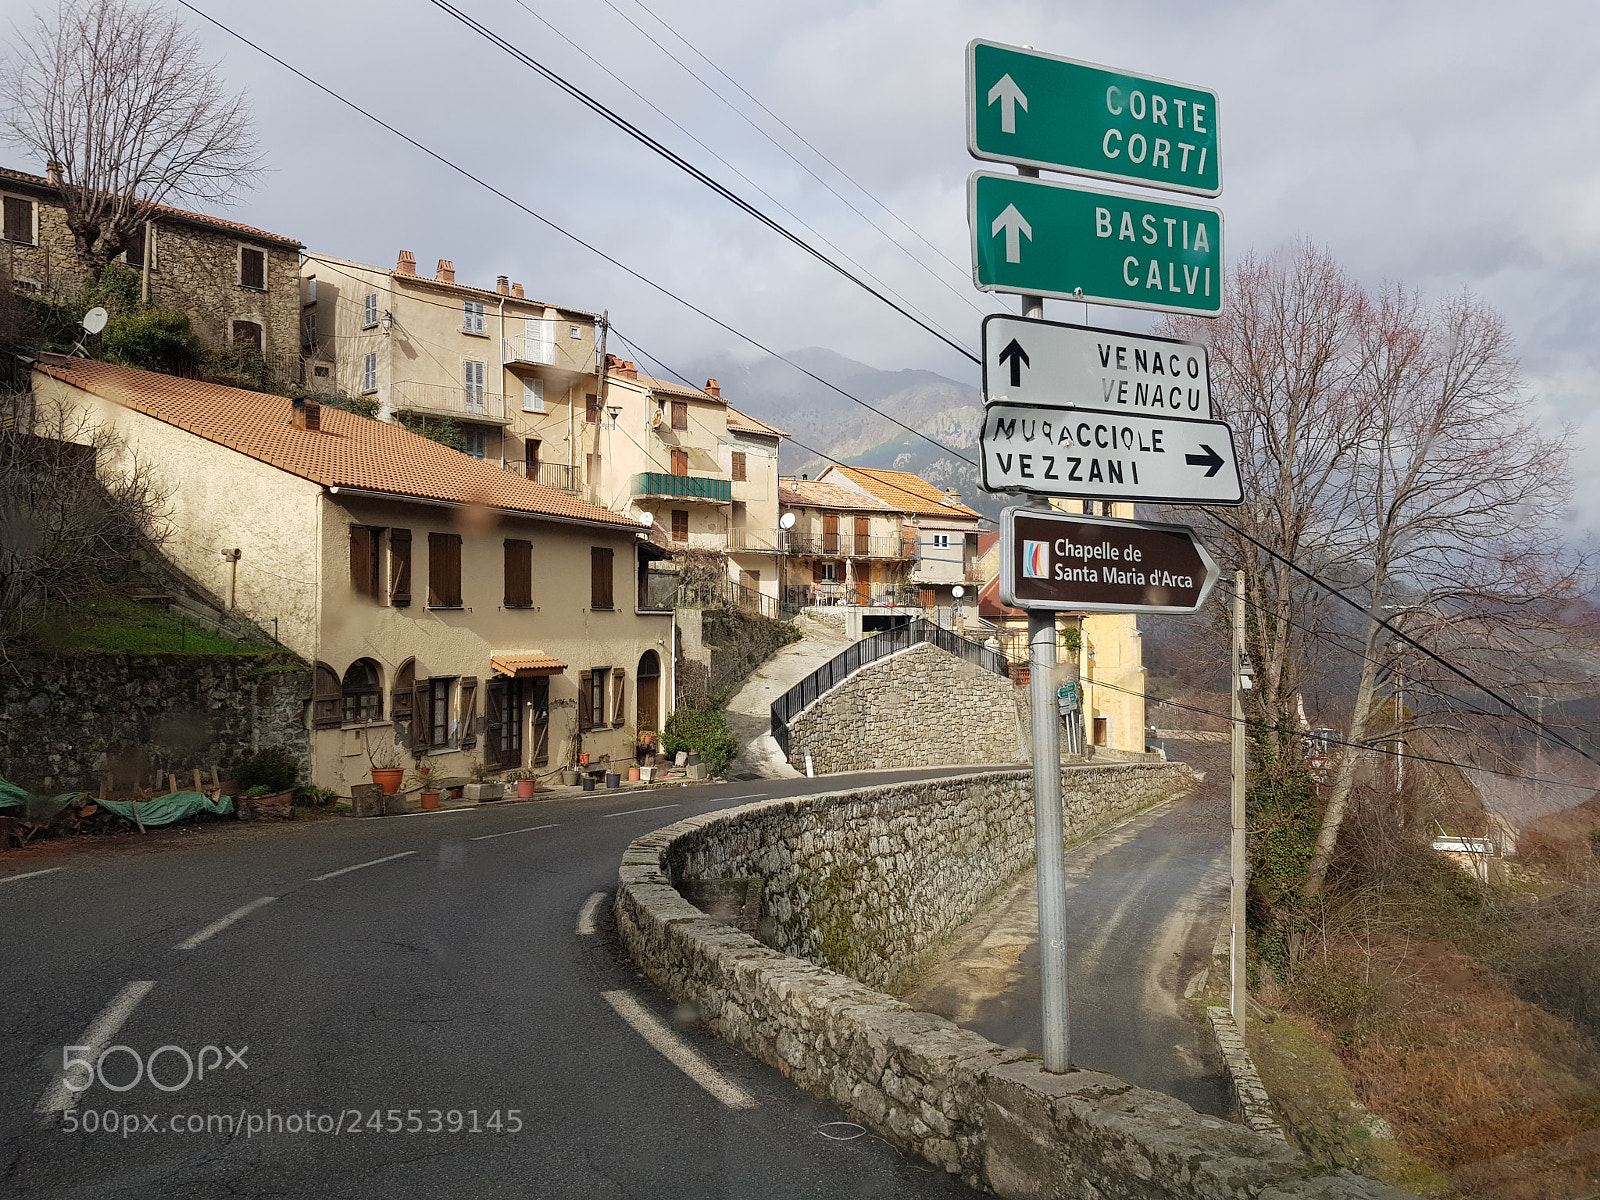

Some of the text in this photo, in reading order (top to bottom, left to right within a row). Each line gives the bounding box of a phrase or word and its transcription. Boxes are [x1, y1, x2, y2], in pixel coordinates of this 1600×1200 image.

[1106, 85, 1207, 133] CORTE
[1102, 128, 1207, 175] CORTI
[1095, 206, 1210, 253] BASTIA
[1123, 256, 1210, 297] CALVI
[1097, 343, 1199, 379] VENACO
[1101, 377, 1200, 412] VENACU
[996, 452, 1139, 485] VEZZANI
[1054, 538, 1142, 562] Chapelle de
[1054, 562, 1193, 588] Santa Maria d'Arca
